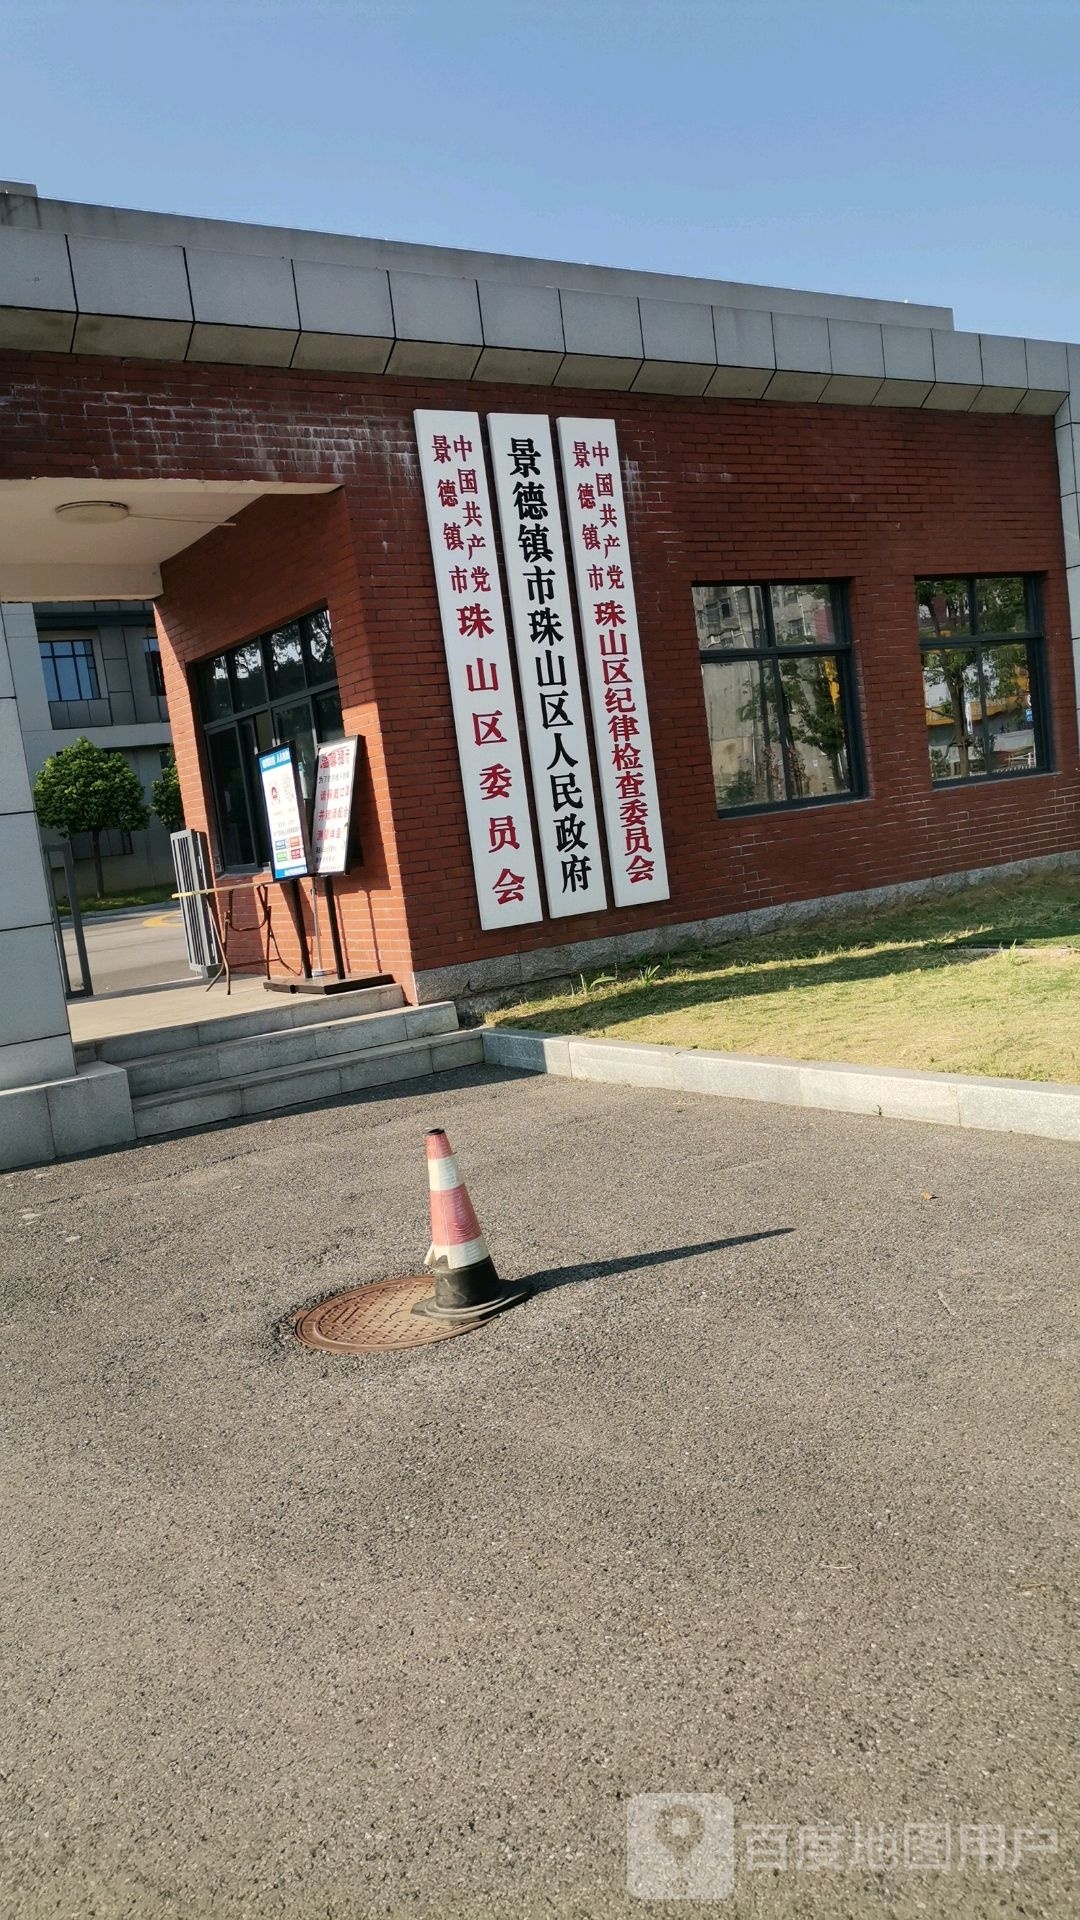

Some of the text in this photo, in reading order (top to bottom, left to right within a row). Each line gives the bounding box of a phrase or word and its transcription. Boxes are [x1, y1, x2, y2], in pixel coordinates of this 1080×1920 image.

[431, 434, 468, 594] 景德镇市
[453, 434, 491, 593] 中国共产党
[572, 440, 604, 591] 景德镇市
[592, 440, 625, 591] 中国共产党
[507, 437, 593, 894] 景德镇市珠山区人民政府
[594, 599, 655, 885] 珠山区纪律检查委员会
[456, 603, 526, 905] 珠山区委员会
